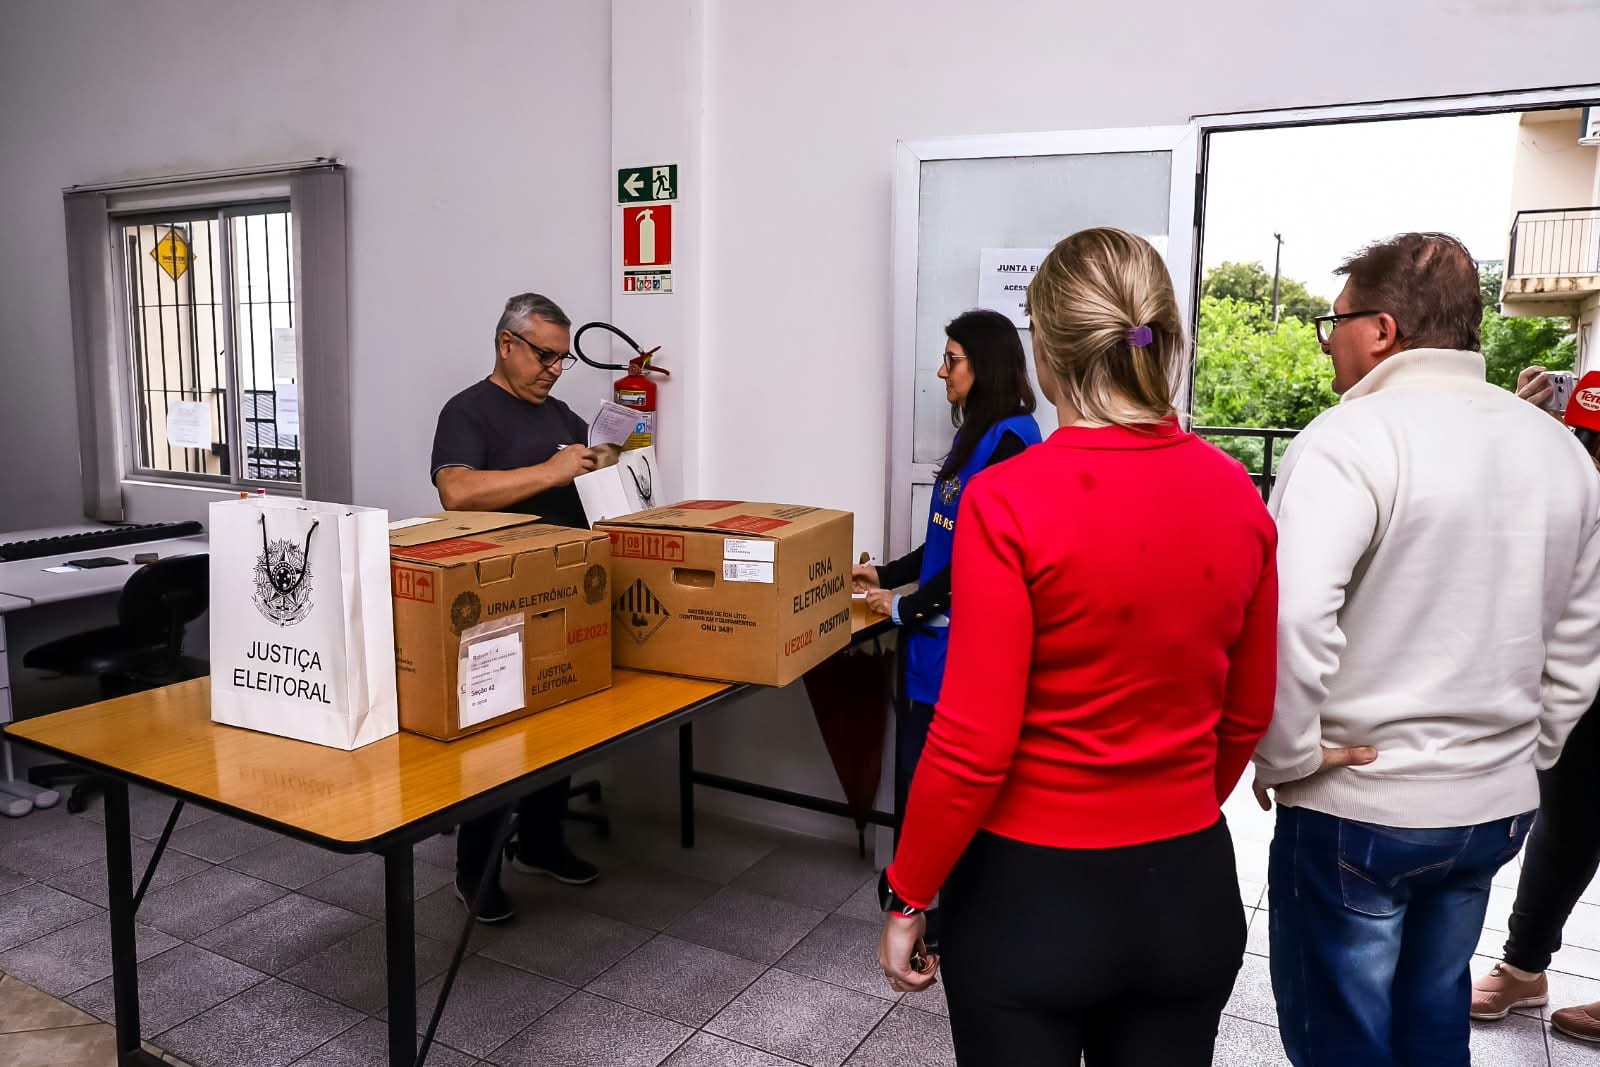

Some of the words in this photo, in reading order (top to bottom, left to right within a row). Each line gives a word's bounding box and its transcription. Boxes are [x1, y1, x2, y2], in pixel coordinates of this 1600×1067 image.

[997, 264, 1028, 272] JUNTA
[808, 556, 833, 581] URNA
[487, 599, 517, 616] URNA
[518, 585, 578, 609] ELETRÔNICA
[793, 573, 845, 614] ELETRÔNICA
[567, 622, 609, 646] UE2022
[701, 623, 717, 632] ONU
[818, 607, 850, 638] POSITIVO
[246, 640, 322, 673] JUSTIÇA
[784, 629, 813, 657] UE2022
[233, 668, 331, 704] ELEITORAL
[531, 674, 578, 697] ELEITORAL
